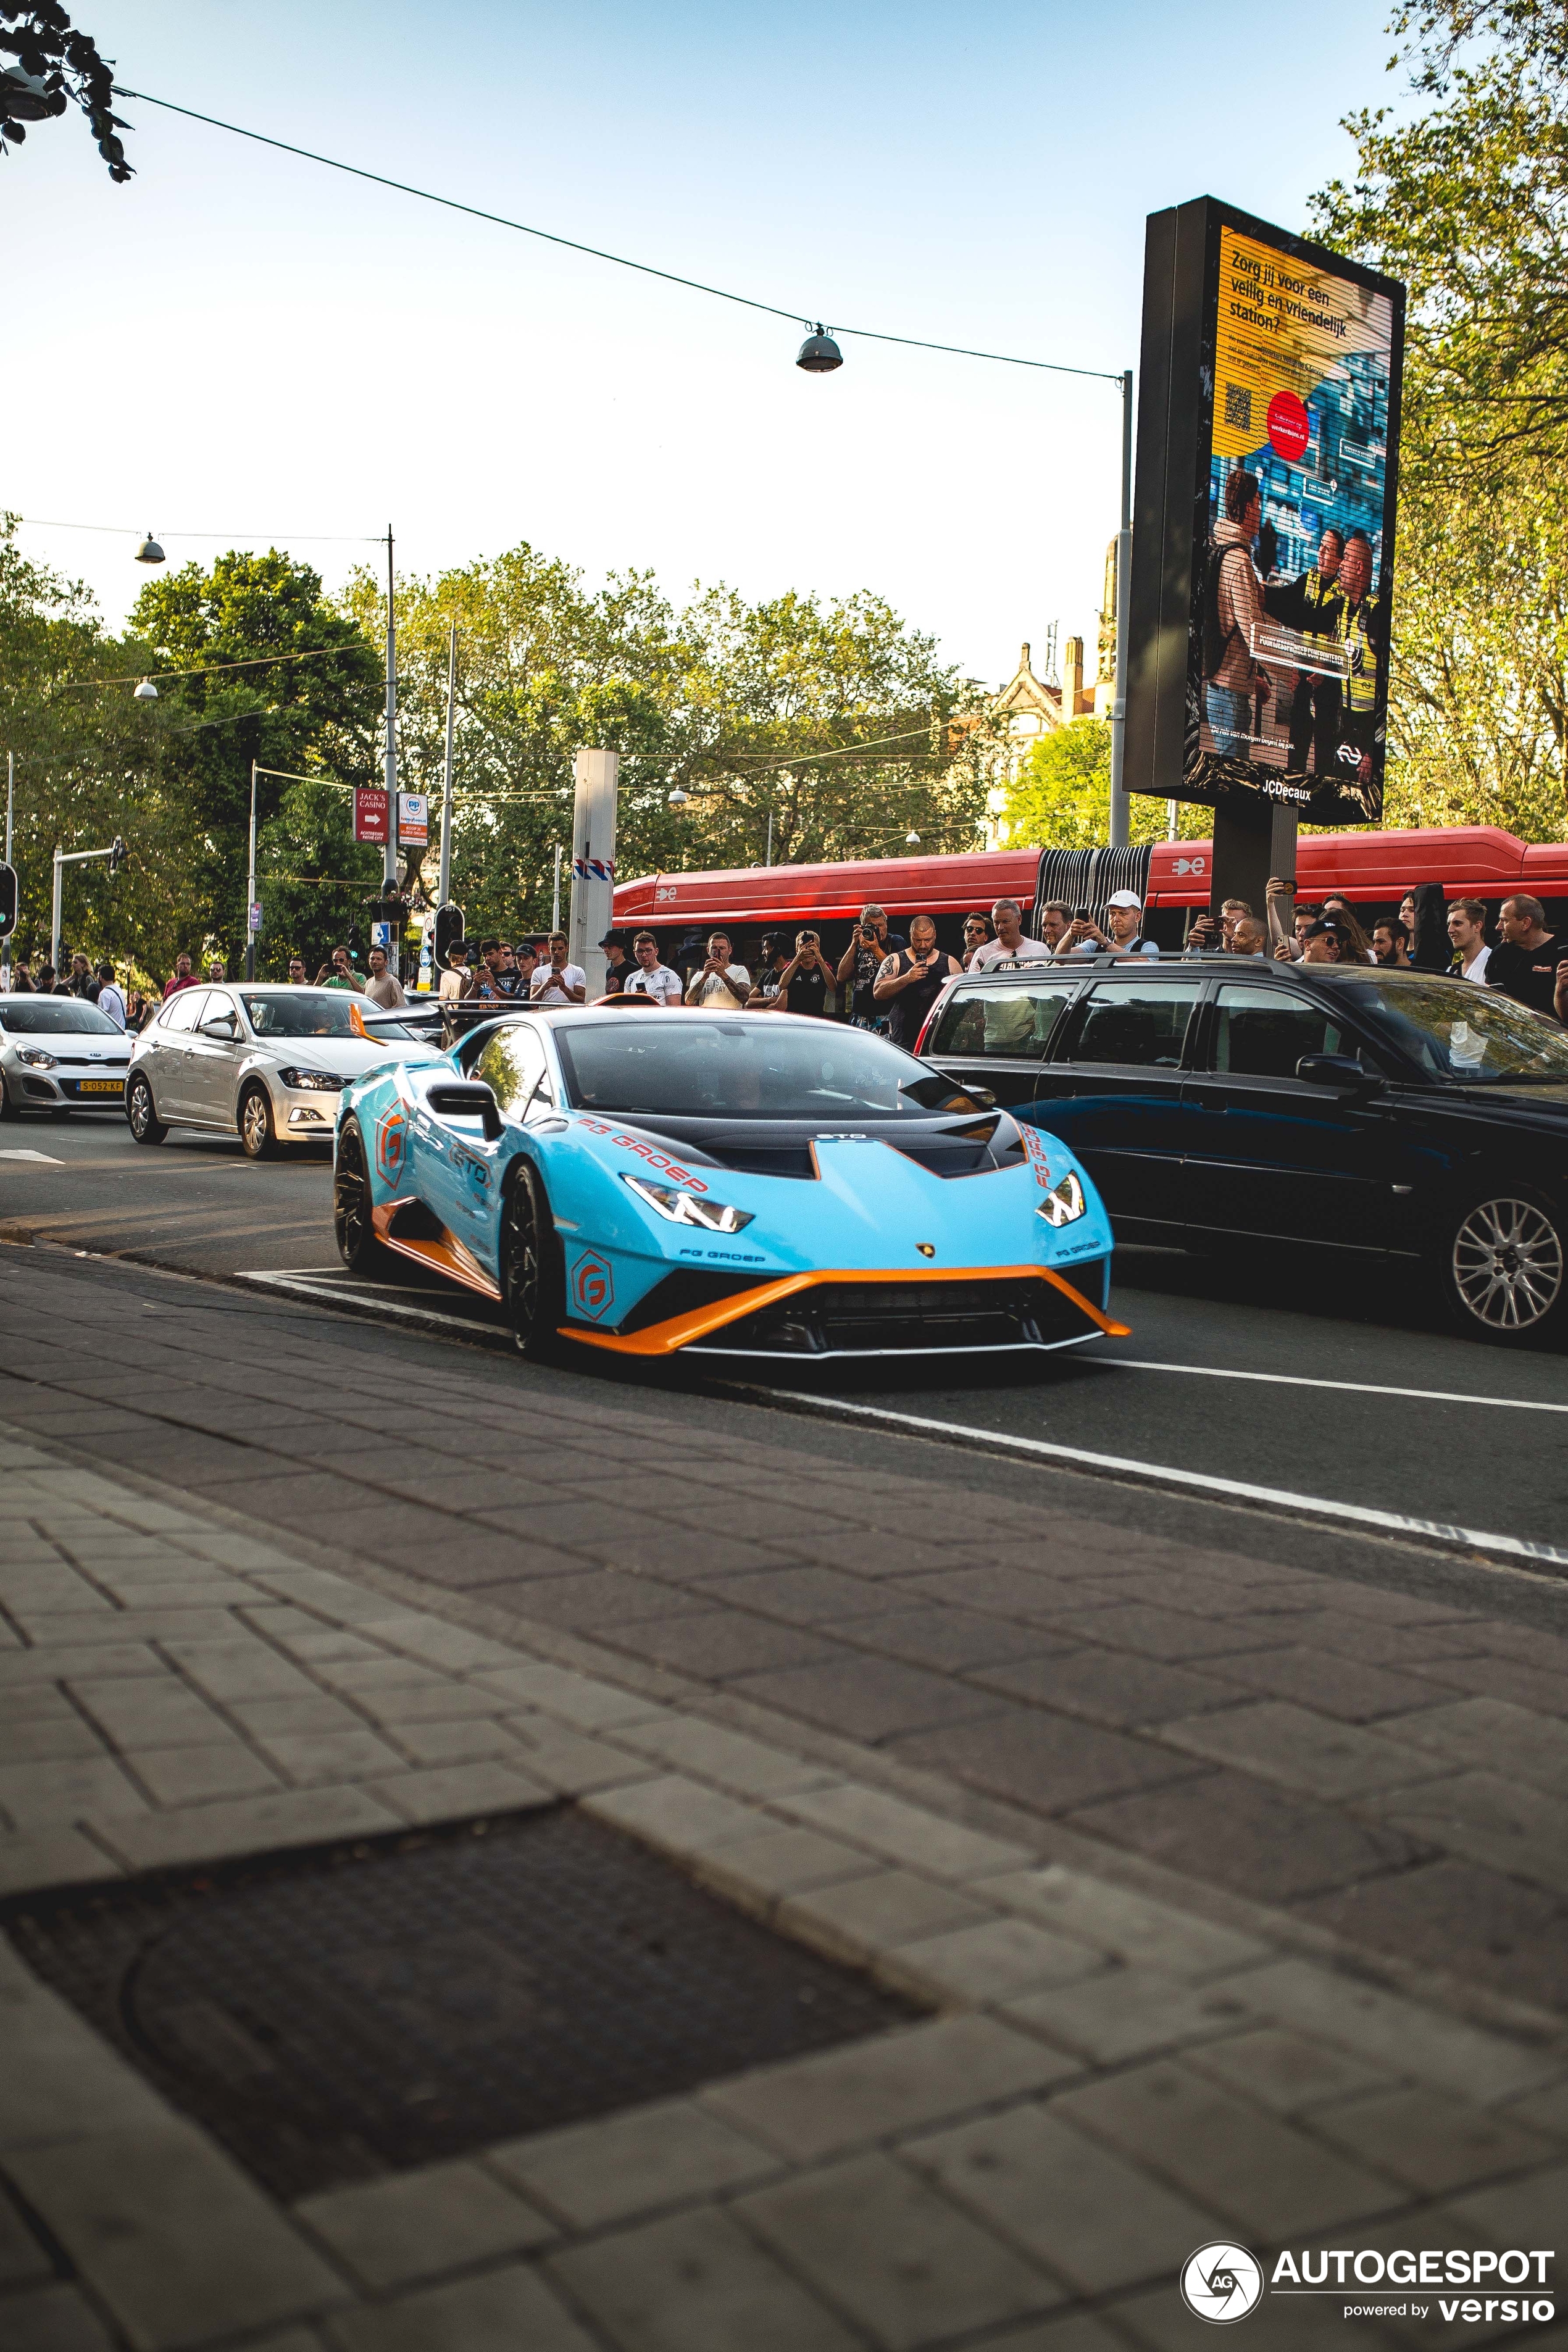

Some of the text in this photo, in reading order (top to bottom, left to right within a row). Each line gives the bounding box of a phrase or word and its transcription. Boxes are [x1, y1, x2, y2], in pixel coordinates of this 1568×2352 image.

[1232, 250, 1329, 307] Zorg jij voor een
[1230, 301, 1280, 332] station?
[1232, 278, 1346, 338] veilig en vriendelijk
[360, 793, 385, 802] JACK'S
[1263, 779, 1311, 801] JCDecaux
[360, 801, 385, 809] CASINO
[577, 1119, 709, 1193] FG GROEP
[680, 1248, 765, 1262] FG GROEP
